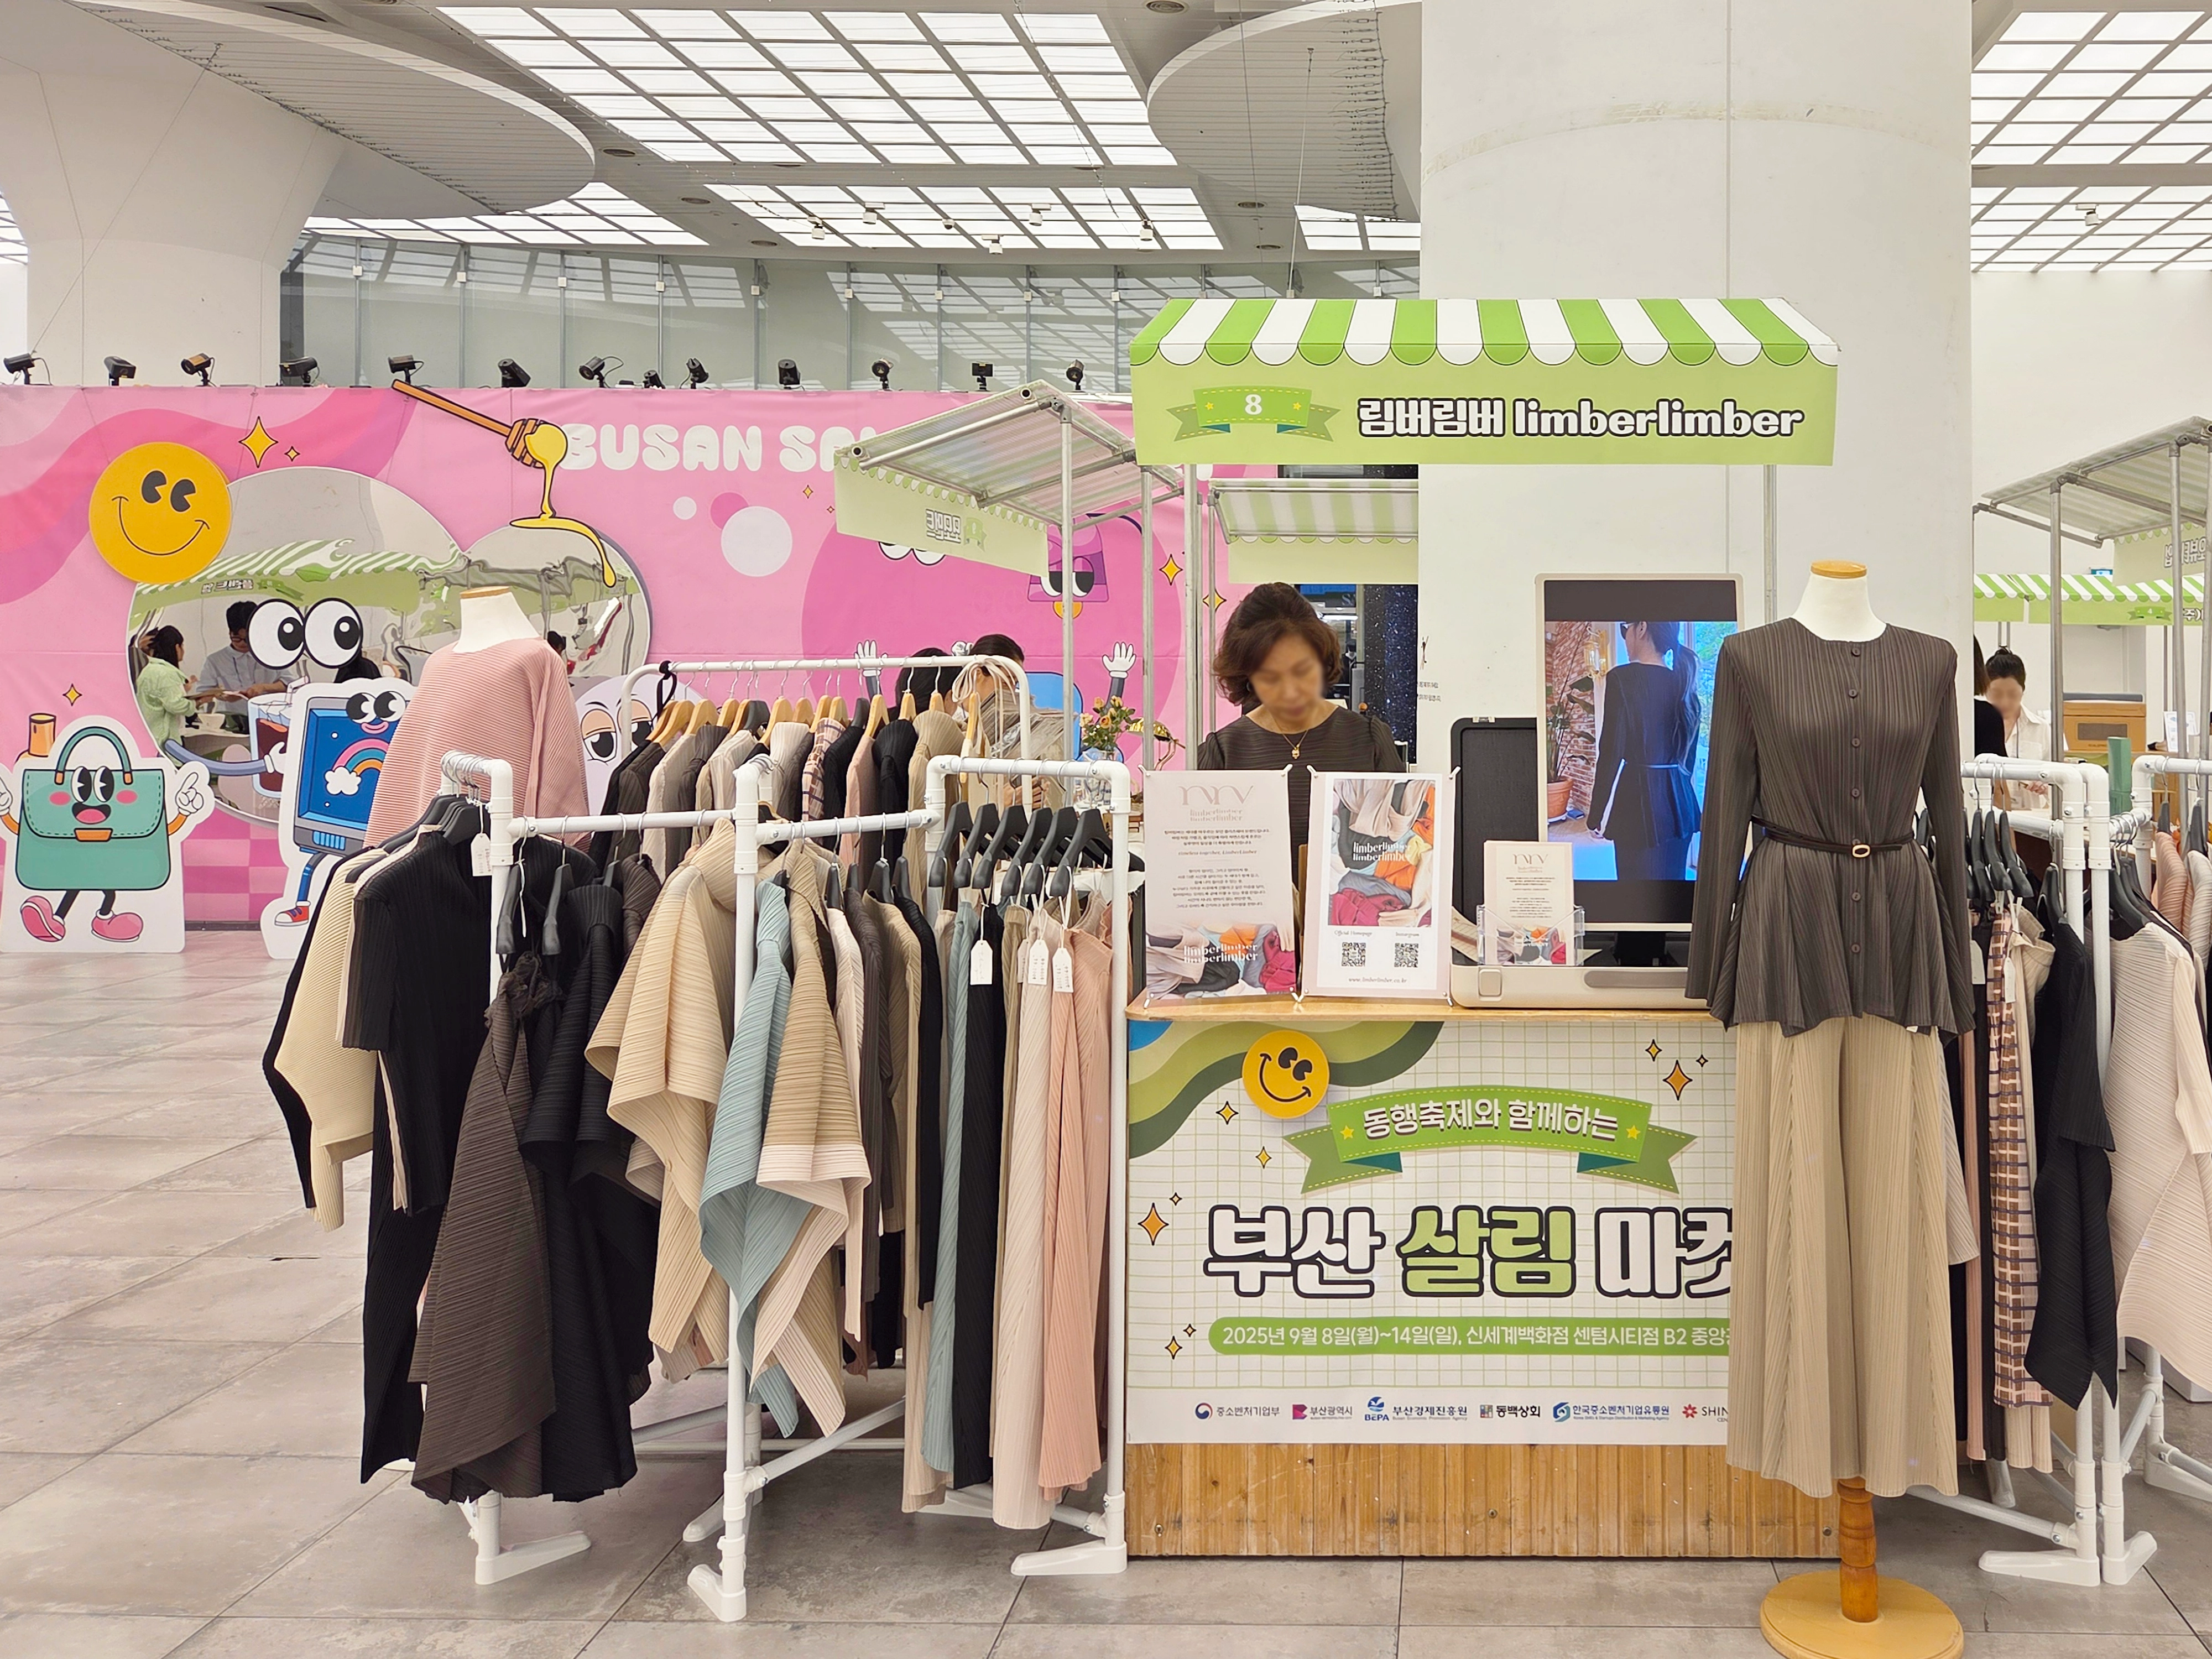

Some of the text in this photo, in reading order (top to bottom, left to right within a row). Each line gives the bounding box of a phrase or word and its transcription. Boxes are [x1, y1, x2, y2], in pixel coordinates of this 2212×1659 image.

[1245, 394, 1262, 415] 8
[1358, 397, 1805, 437] 림버림버 limberlimber
[560, 423, 877, 472] BUSAN SA
[1363, 1098, 1619, 1141] 동행축제와 함께하는
[1203, 1204, 1386, 1298] 부산
[1395, 1204, 1576, 1298] 살림
[1223, 1326, 1730, 1346] 2025년 9월 8일(월)~14일(일), 신세계백화점 센텀시티점 B2 중앙
[1217, 1405, 1280, 1417] 중소벤처기업부
[1310, 1406, 1352, 1416] 부산광역시
[1392, 1406, 1467, 1416] 부산경제진흥원
[1496, 1405, 1541, 1418] 동백상회
[1573, 1405, 1670, 1416] 한국중소벤처기업유통원
